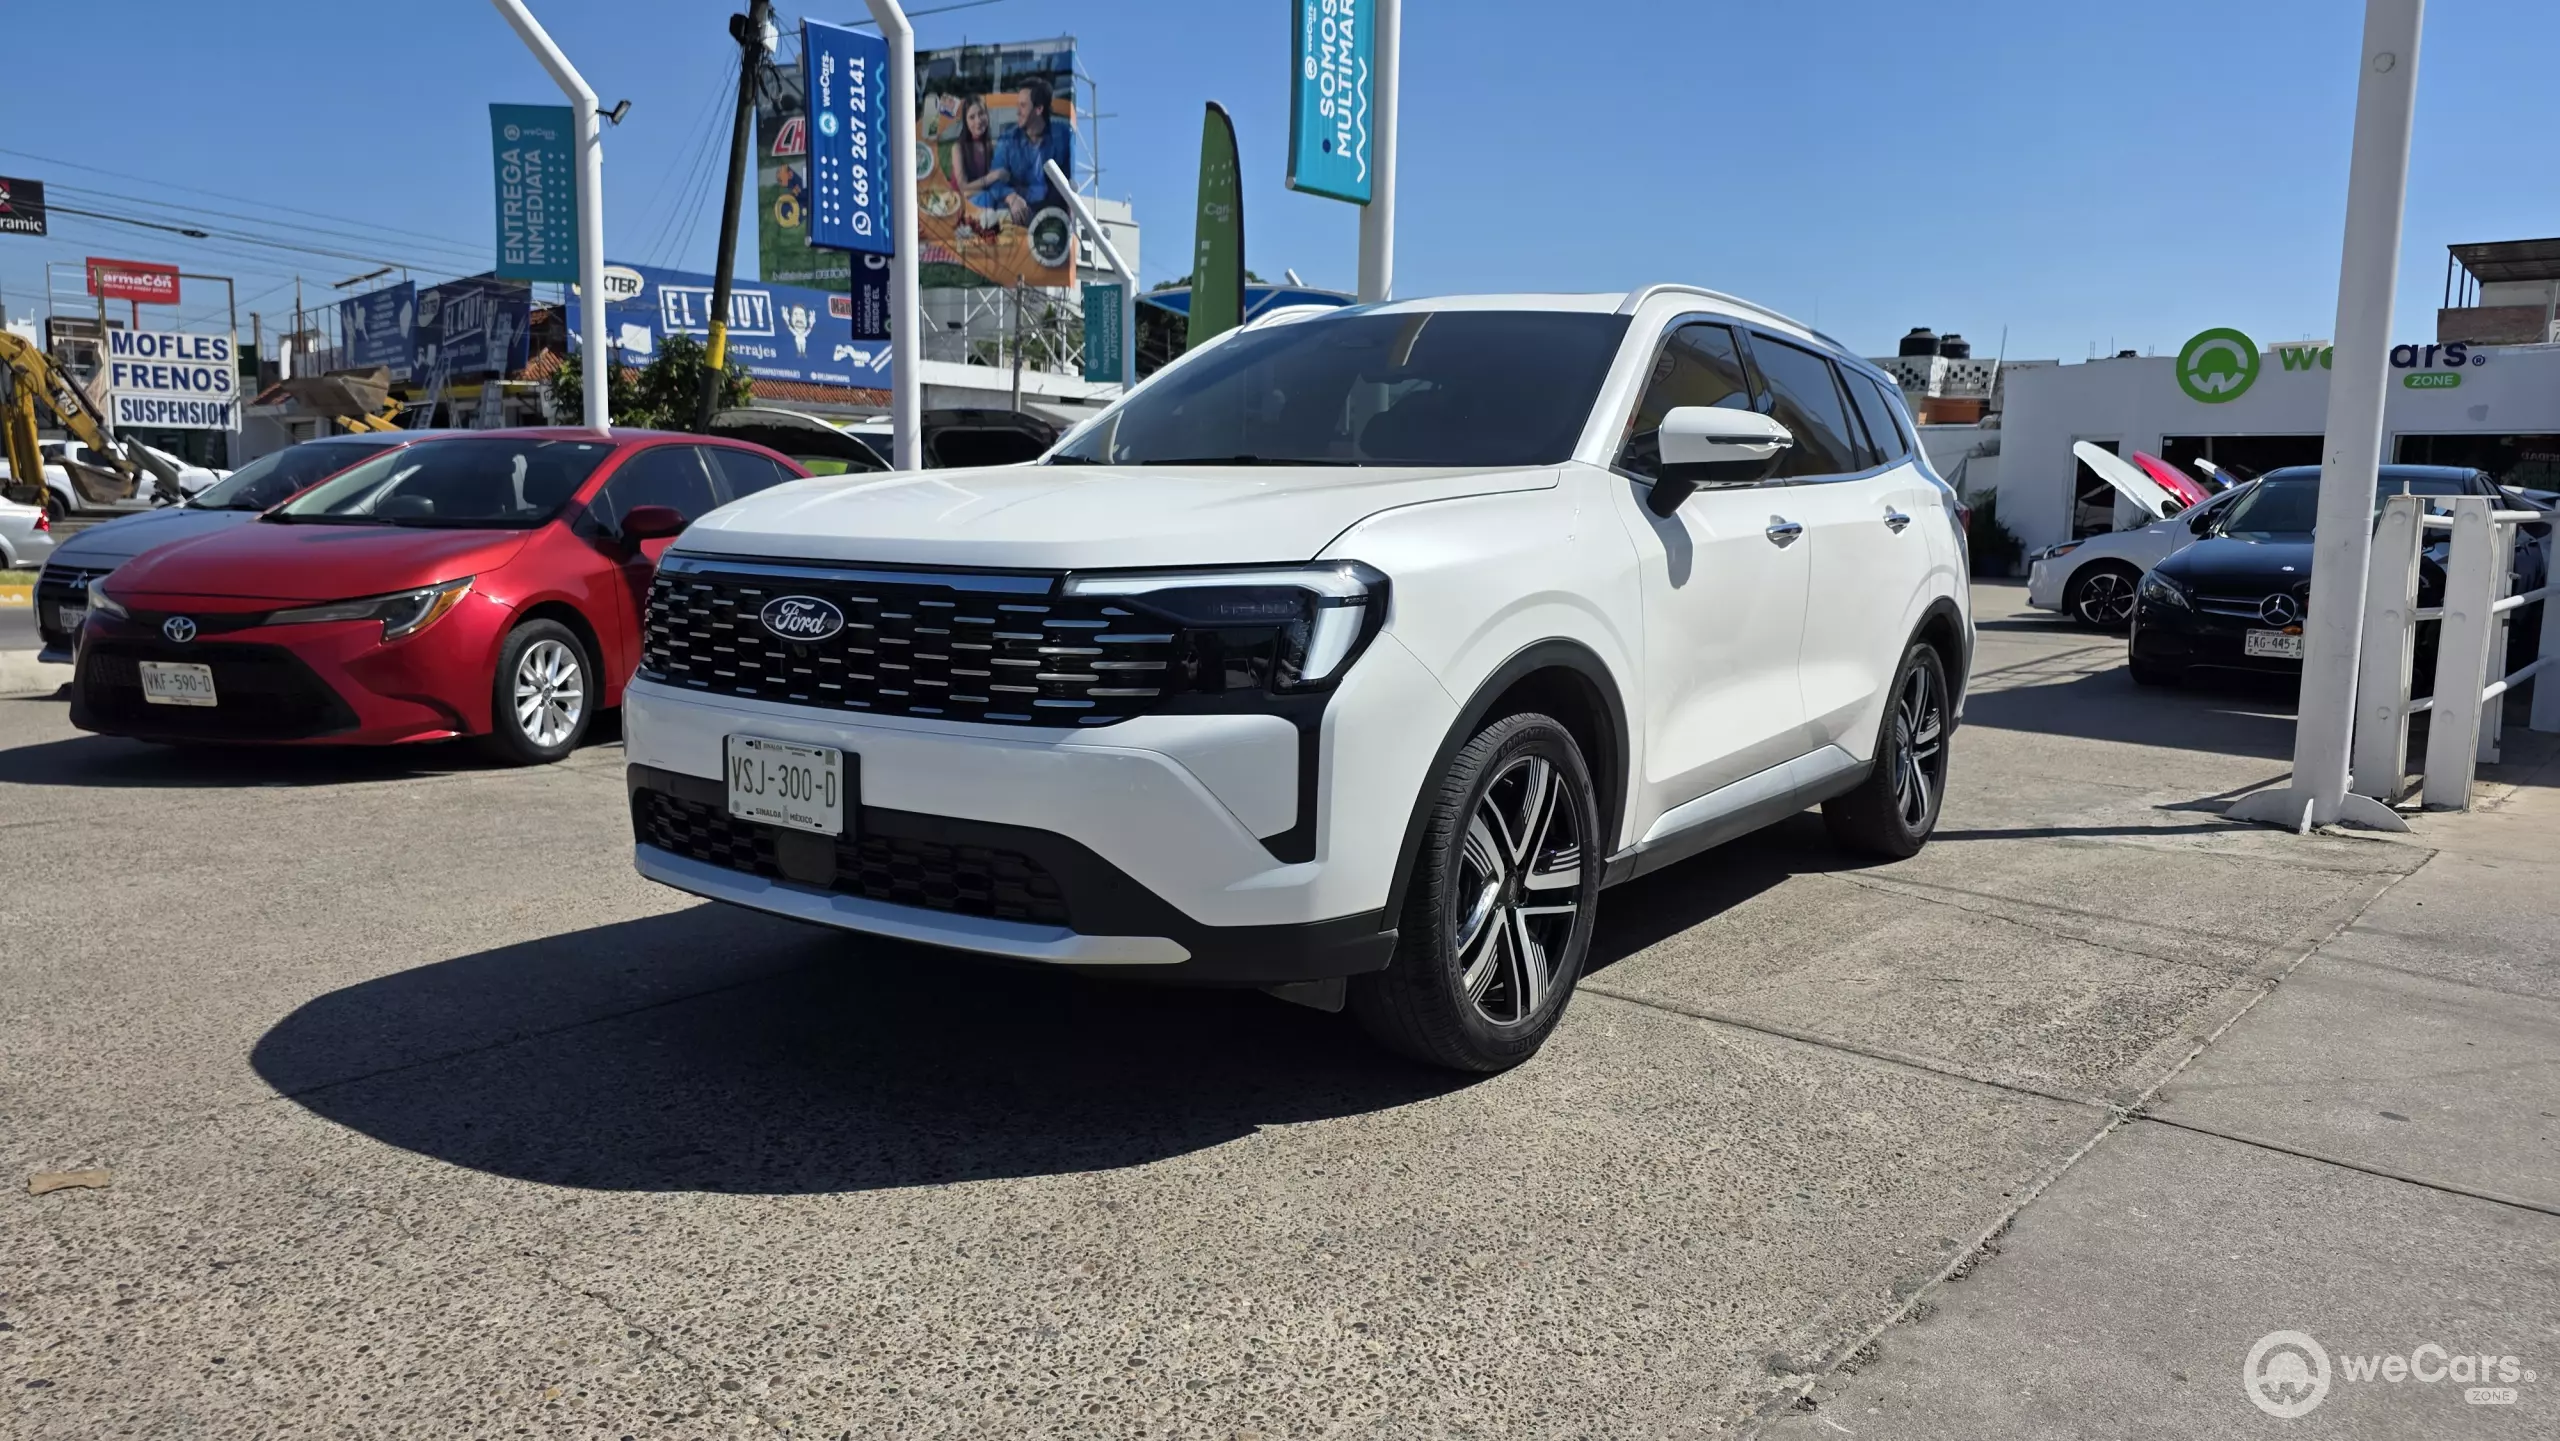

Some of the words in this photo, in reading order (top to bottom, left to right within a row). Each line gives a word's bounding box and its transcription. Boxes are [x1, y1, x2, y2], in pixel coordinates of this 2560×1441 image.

[1320, 0, 1337, 119] SOMOS
[849, 56, 866, 113] 2141
[851, 116, 867, 161] 267
[852, 169, 869, 207] 669
[501, 148, 525, 265] ENTREGA
[524, 150, 546, 265] INMEDIATA
[665, 291, 696, 326] EL
[1110, 290, 1118, 359] AUTOMOTRIZ
[111, 331, 229, 361] MOFLES
[728, 342, 777, 358] errajes
[111, 363, 231, 392] FRENOS
[2411, 375, 2454, 387] ZONE
[121, 398, 230, 426] SUSPENSION
[775, 600, 828, 634] Ford
[2247, 635, 2302, 651] EKG-445-A
[731, 755, 836, 808] VSJ-300-D
[755, 807, 782, 818] SINALOA
